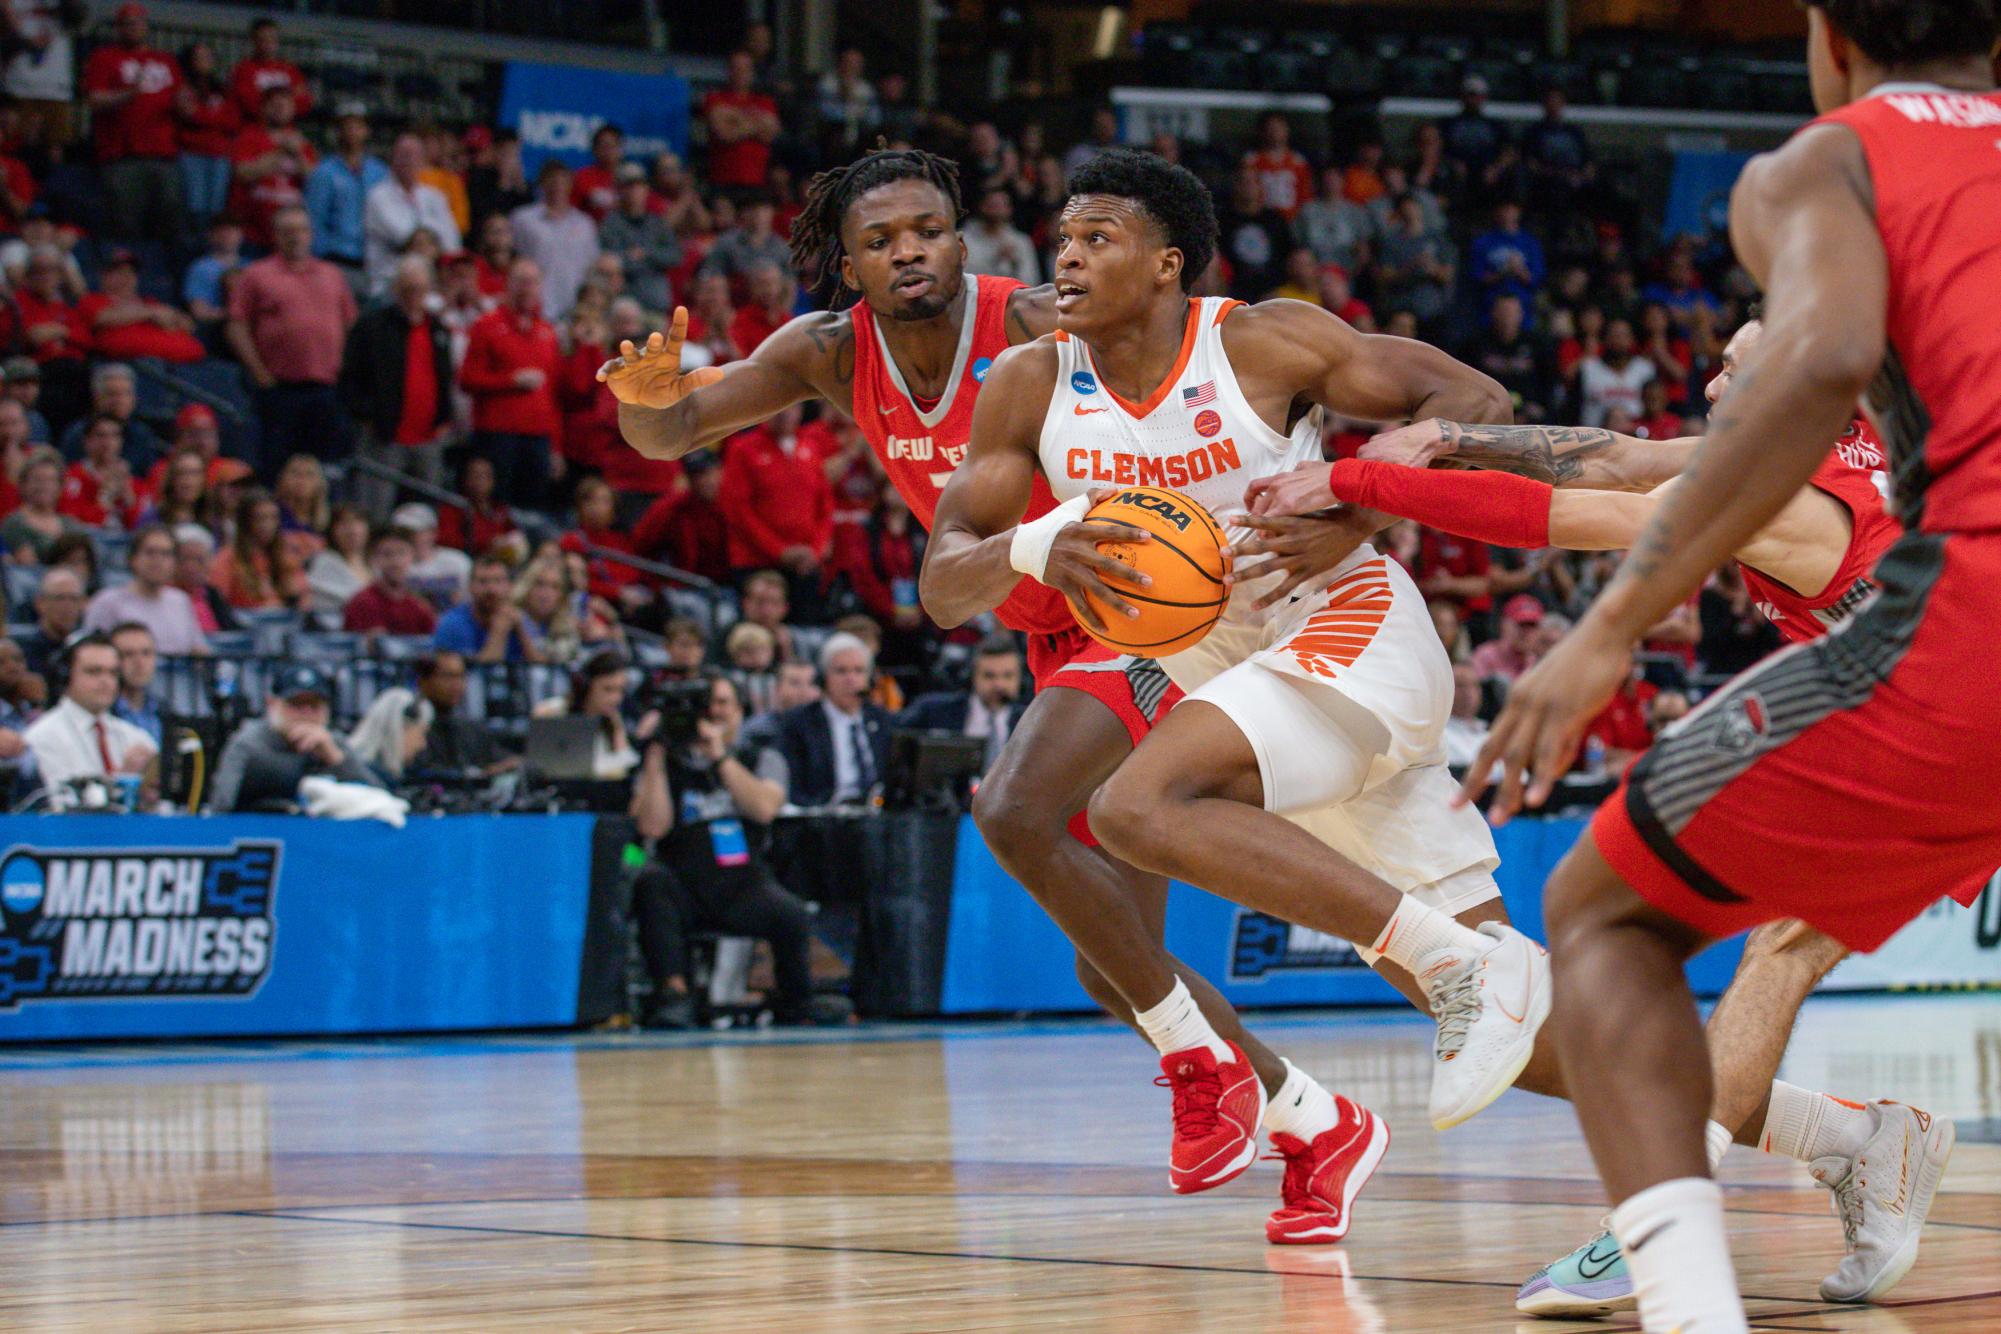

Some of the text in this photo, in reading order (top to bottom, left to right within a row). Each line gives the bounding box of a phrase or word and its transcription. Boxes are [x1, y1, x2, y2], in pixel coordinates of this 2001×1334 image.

[1074, 380, 1096, 391] NCAA
[1066, 438, 1242, 488] CLEMSON
[1111, 492, 1193, 533] NCAA
[43, 858, 204, 918] MARCH
[59, 916, 269, 977] MADNESS
